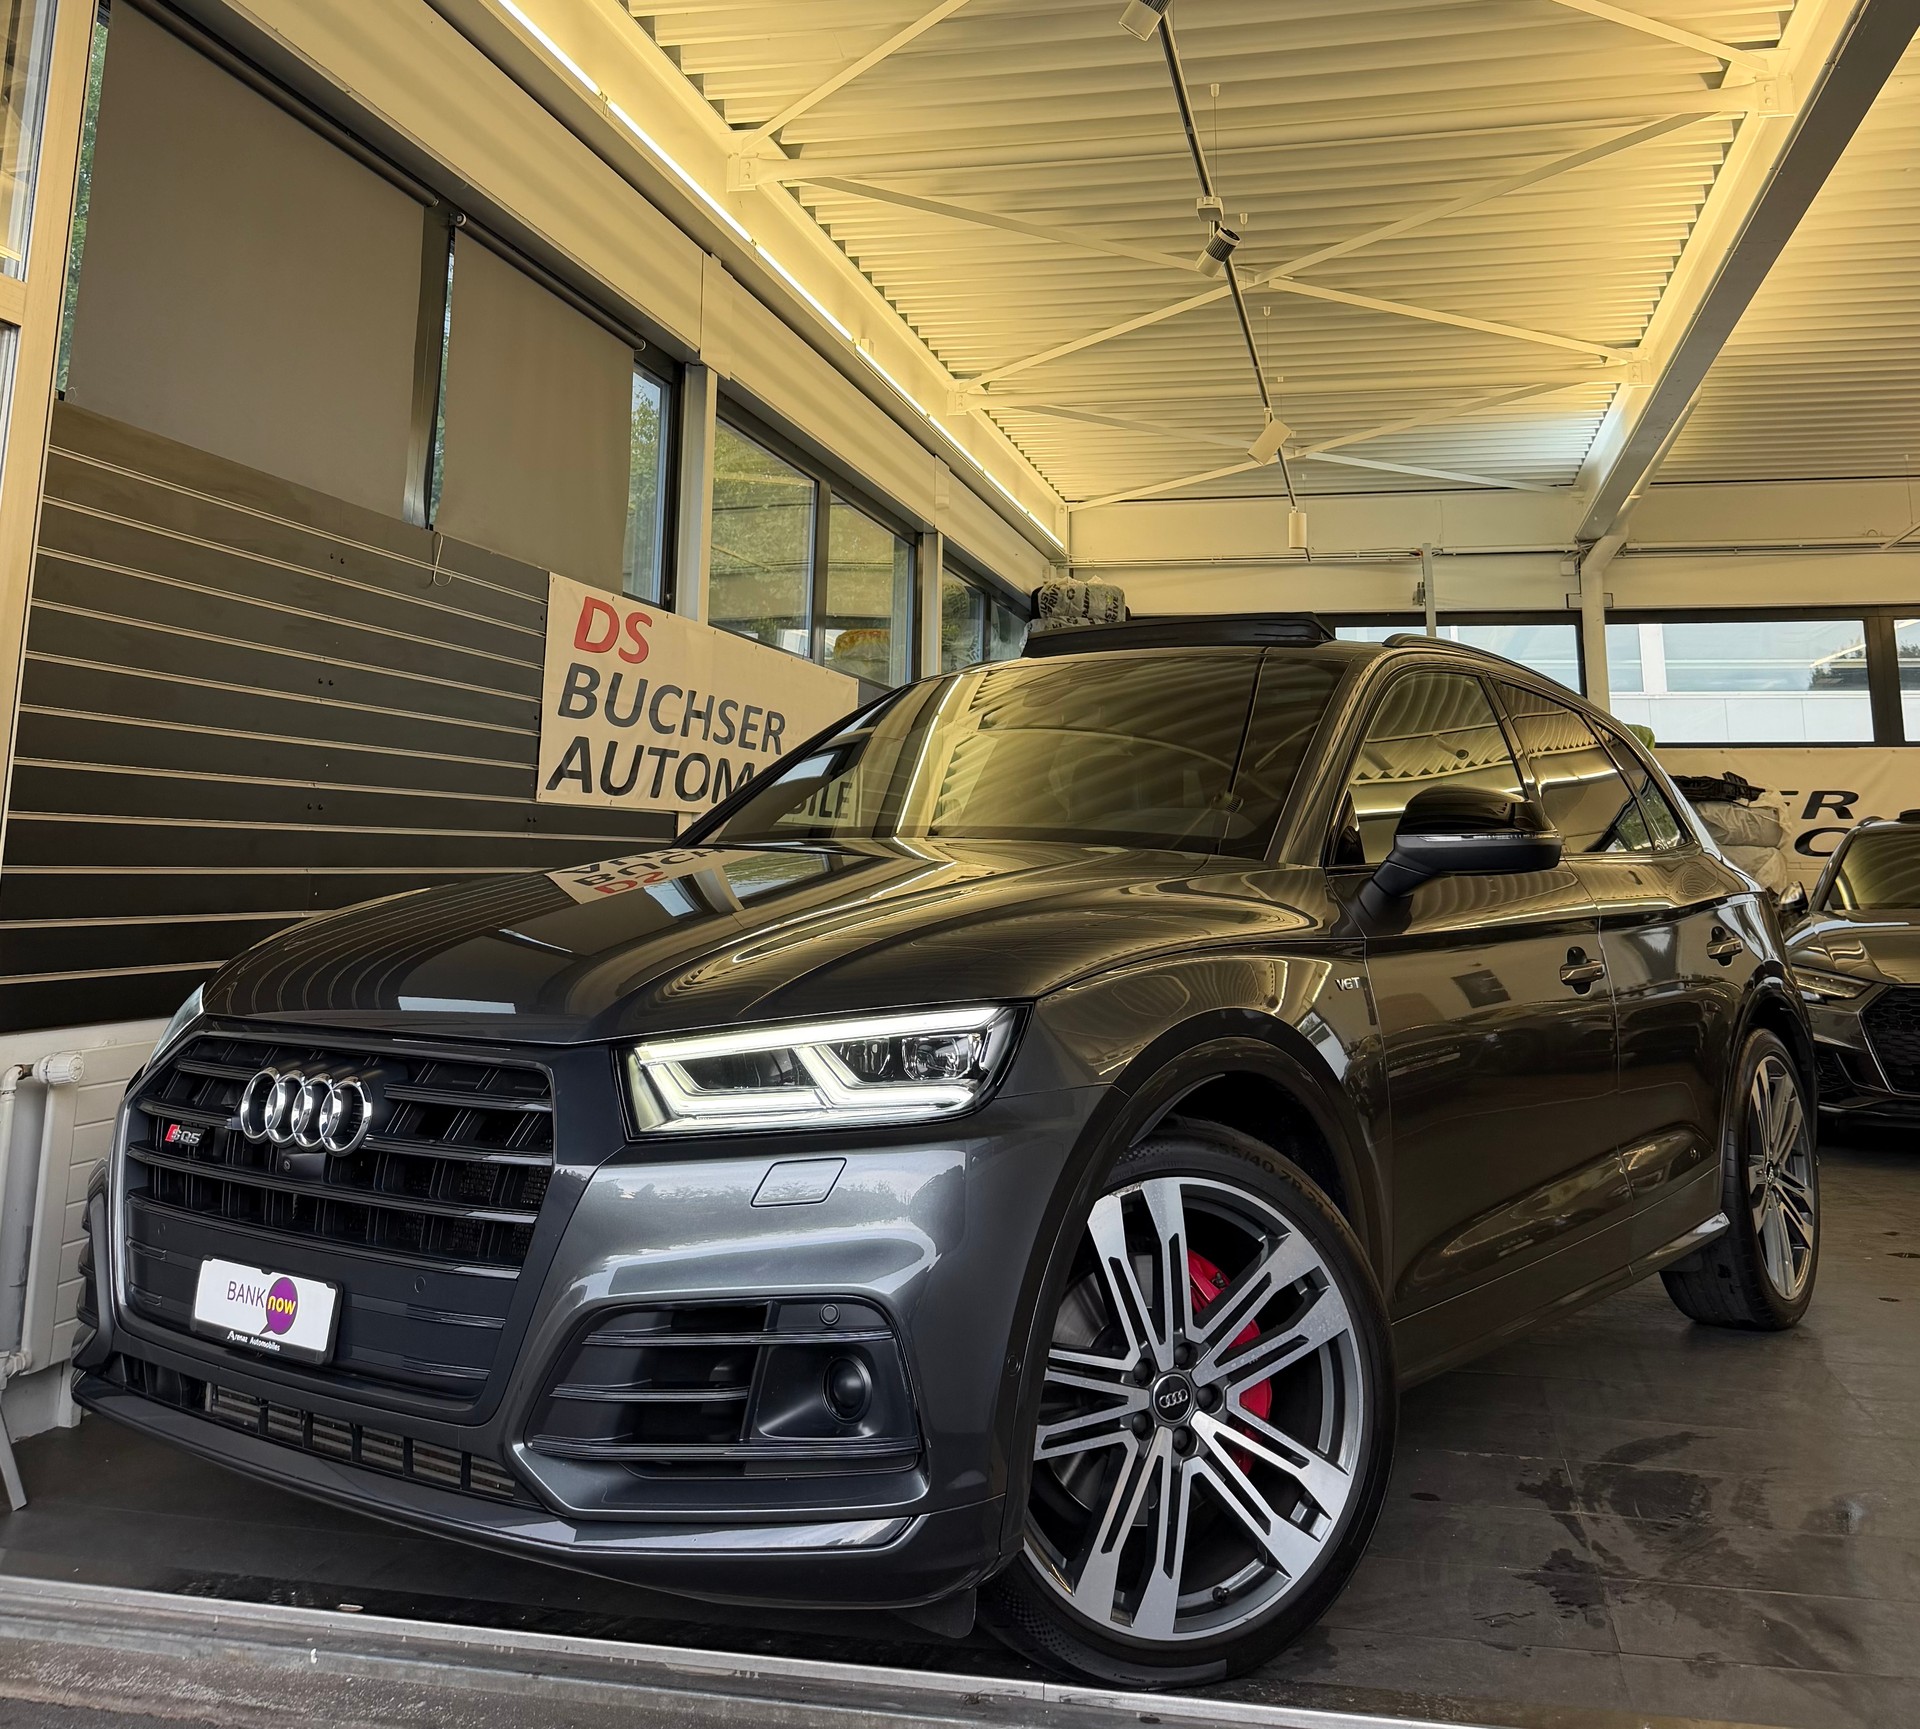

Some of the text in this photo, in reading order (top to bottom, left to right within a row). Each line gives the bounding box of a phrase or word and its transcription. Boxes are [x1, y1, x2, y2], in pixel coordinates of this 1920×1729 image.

[574, 596, 652, 664] DS
[558, 662, 786, 755] BUCHSER
[171, 1129, 202, 1144] SQ5
[227, 1281, 297, 1315] BANK now
